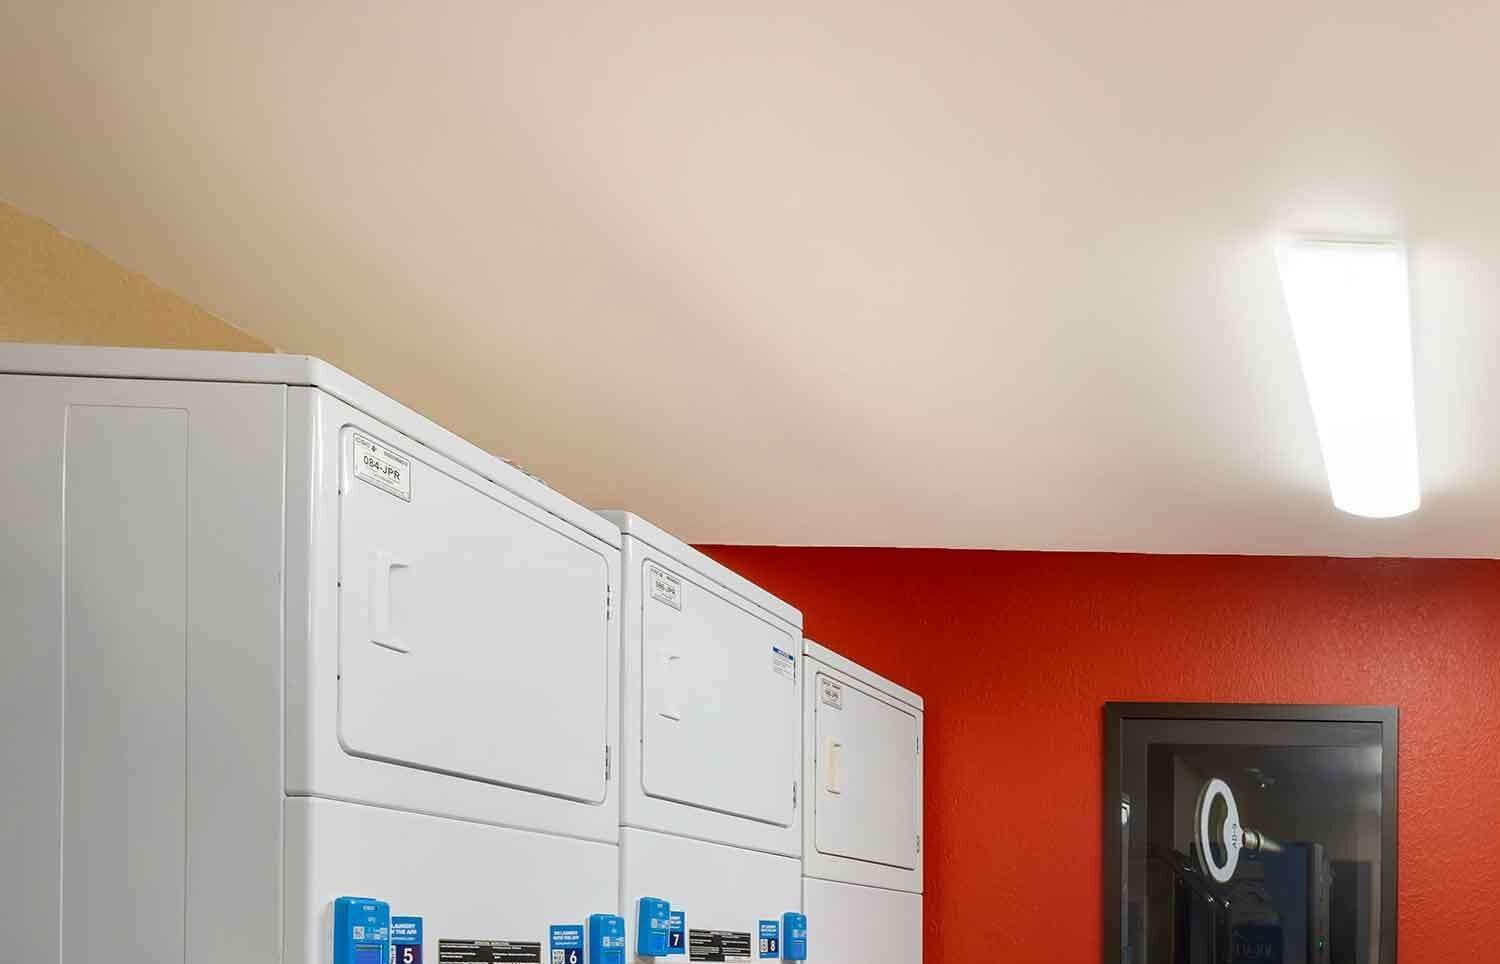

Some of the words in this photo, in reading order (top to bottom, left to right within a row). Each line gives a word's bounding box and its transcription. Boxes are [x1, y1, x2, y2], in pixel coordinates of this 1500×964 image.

[363, 455, 400, 480] 084-JPR
[672, 934, 680, 947] 7
[770, 941, 776, 952] 8
[403, 948, 414, 964] 5
[569, 950, 577, 964] 6
